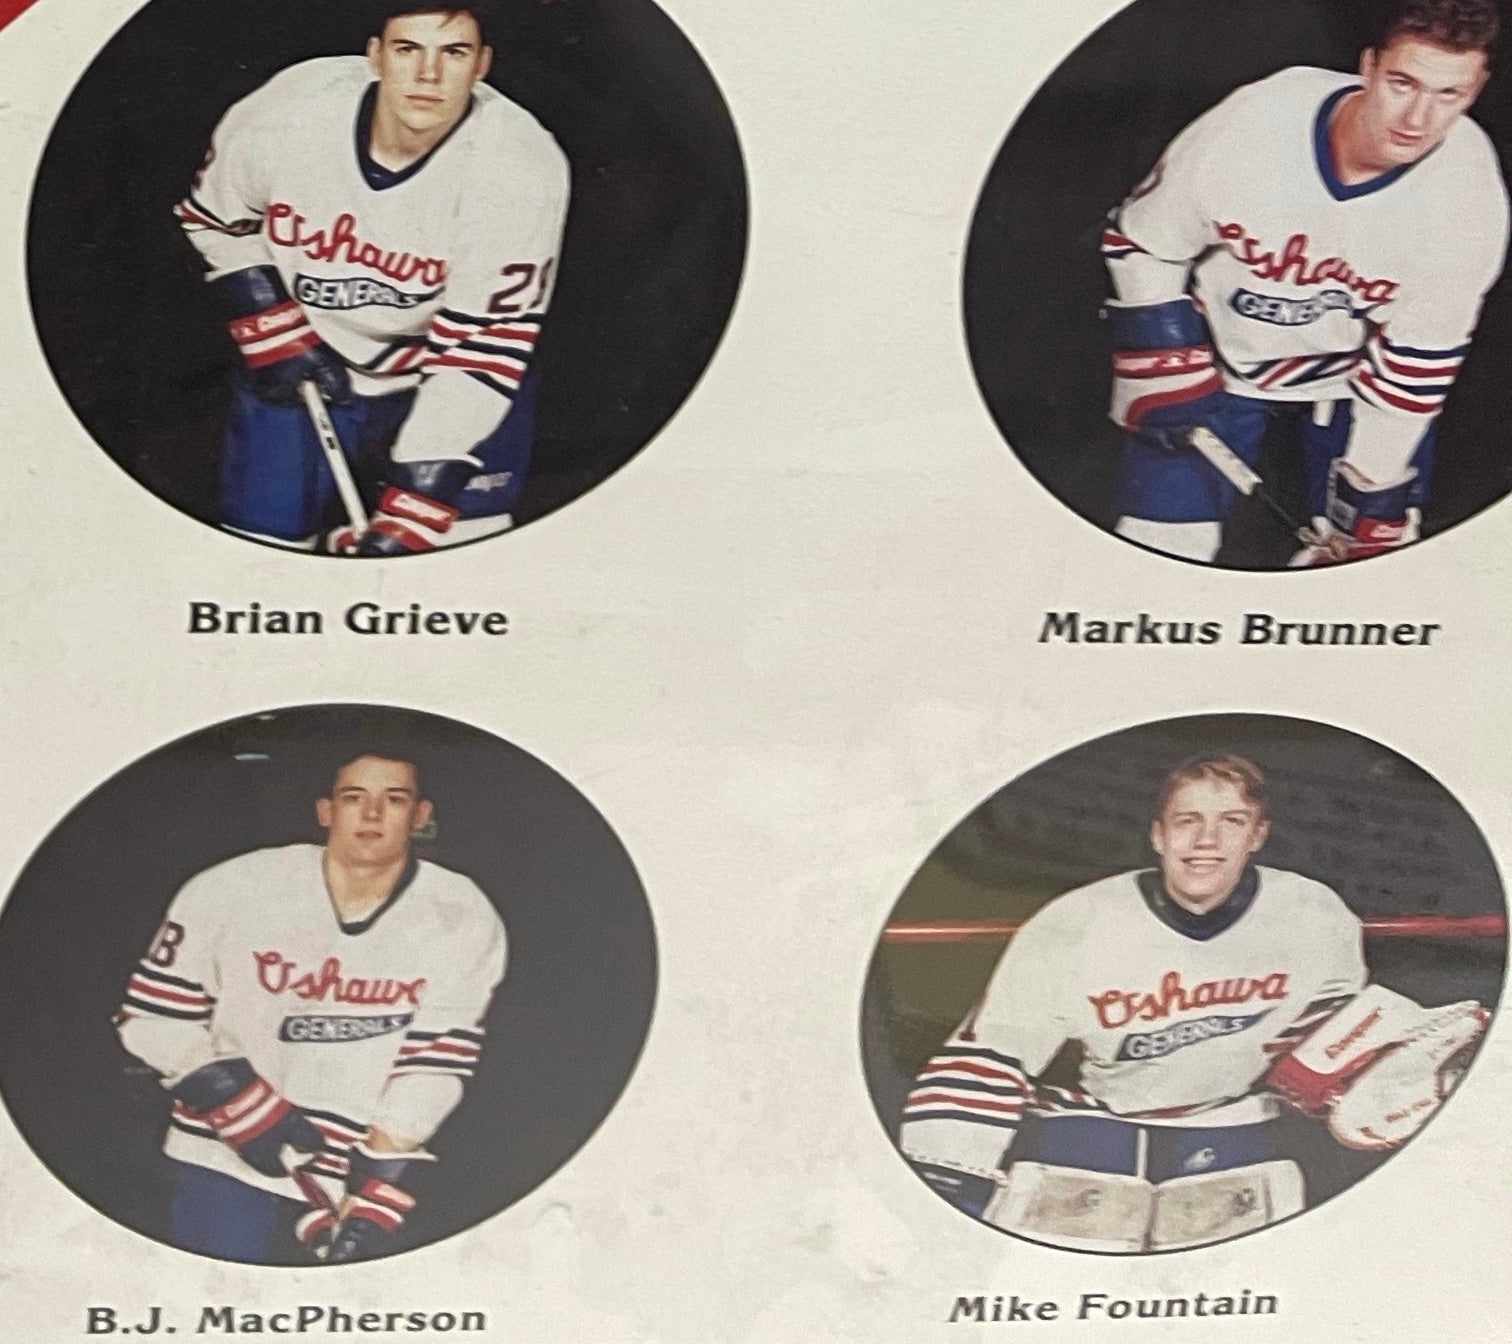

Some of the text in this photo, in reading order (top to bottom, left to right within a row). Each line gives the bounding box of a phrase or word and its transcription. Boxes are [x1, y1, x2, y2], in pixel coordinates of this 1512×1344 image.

[266, 203, 448, 287] Oshawa
[188, 602, 507, 636] Brian Grieve
[1038, 612, 1440, 646] Markus Brunner
[1088, 971, 1290, 1029] Oshawa
[87, 1305, 485, 1335] B.J. MacPherson
[949, 1289, 1277, 1323] Mike Fountain
